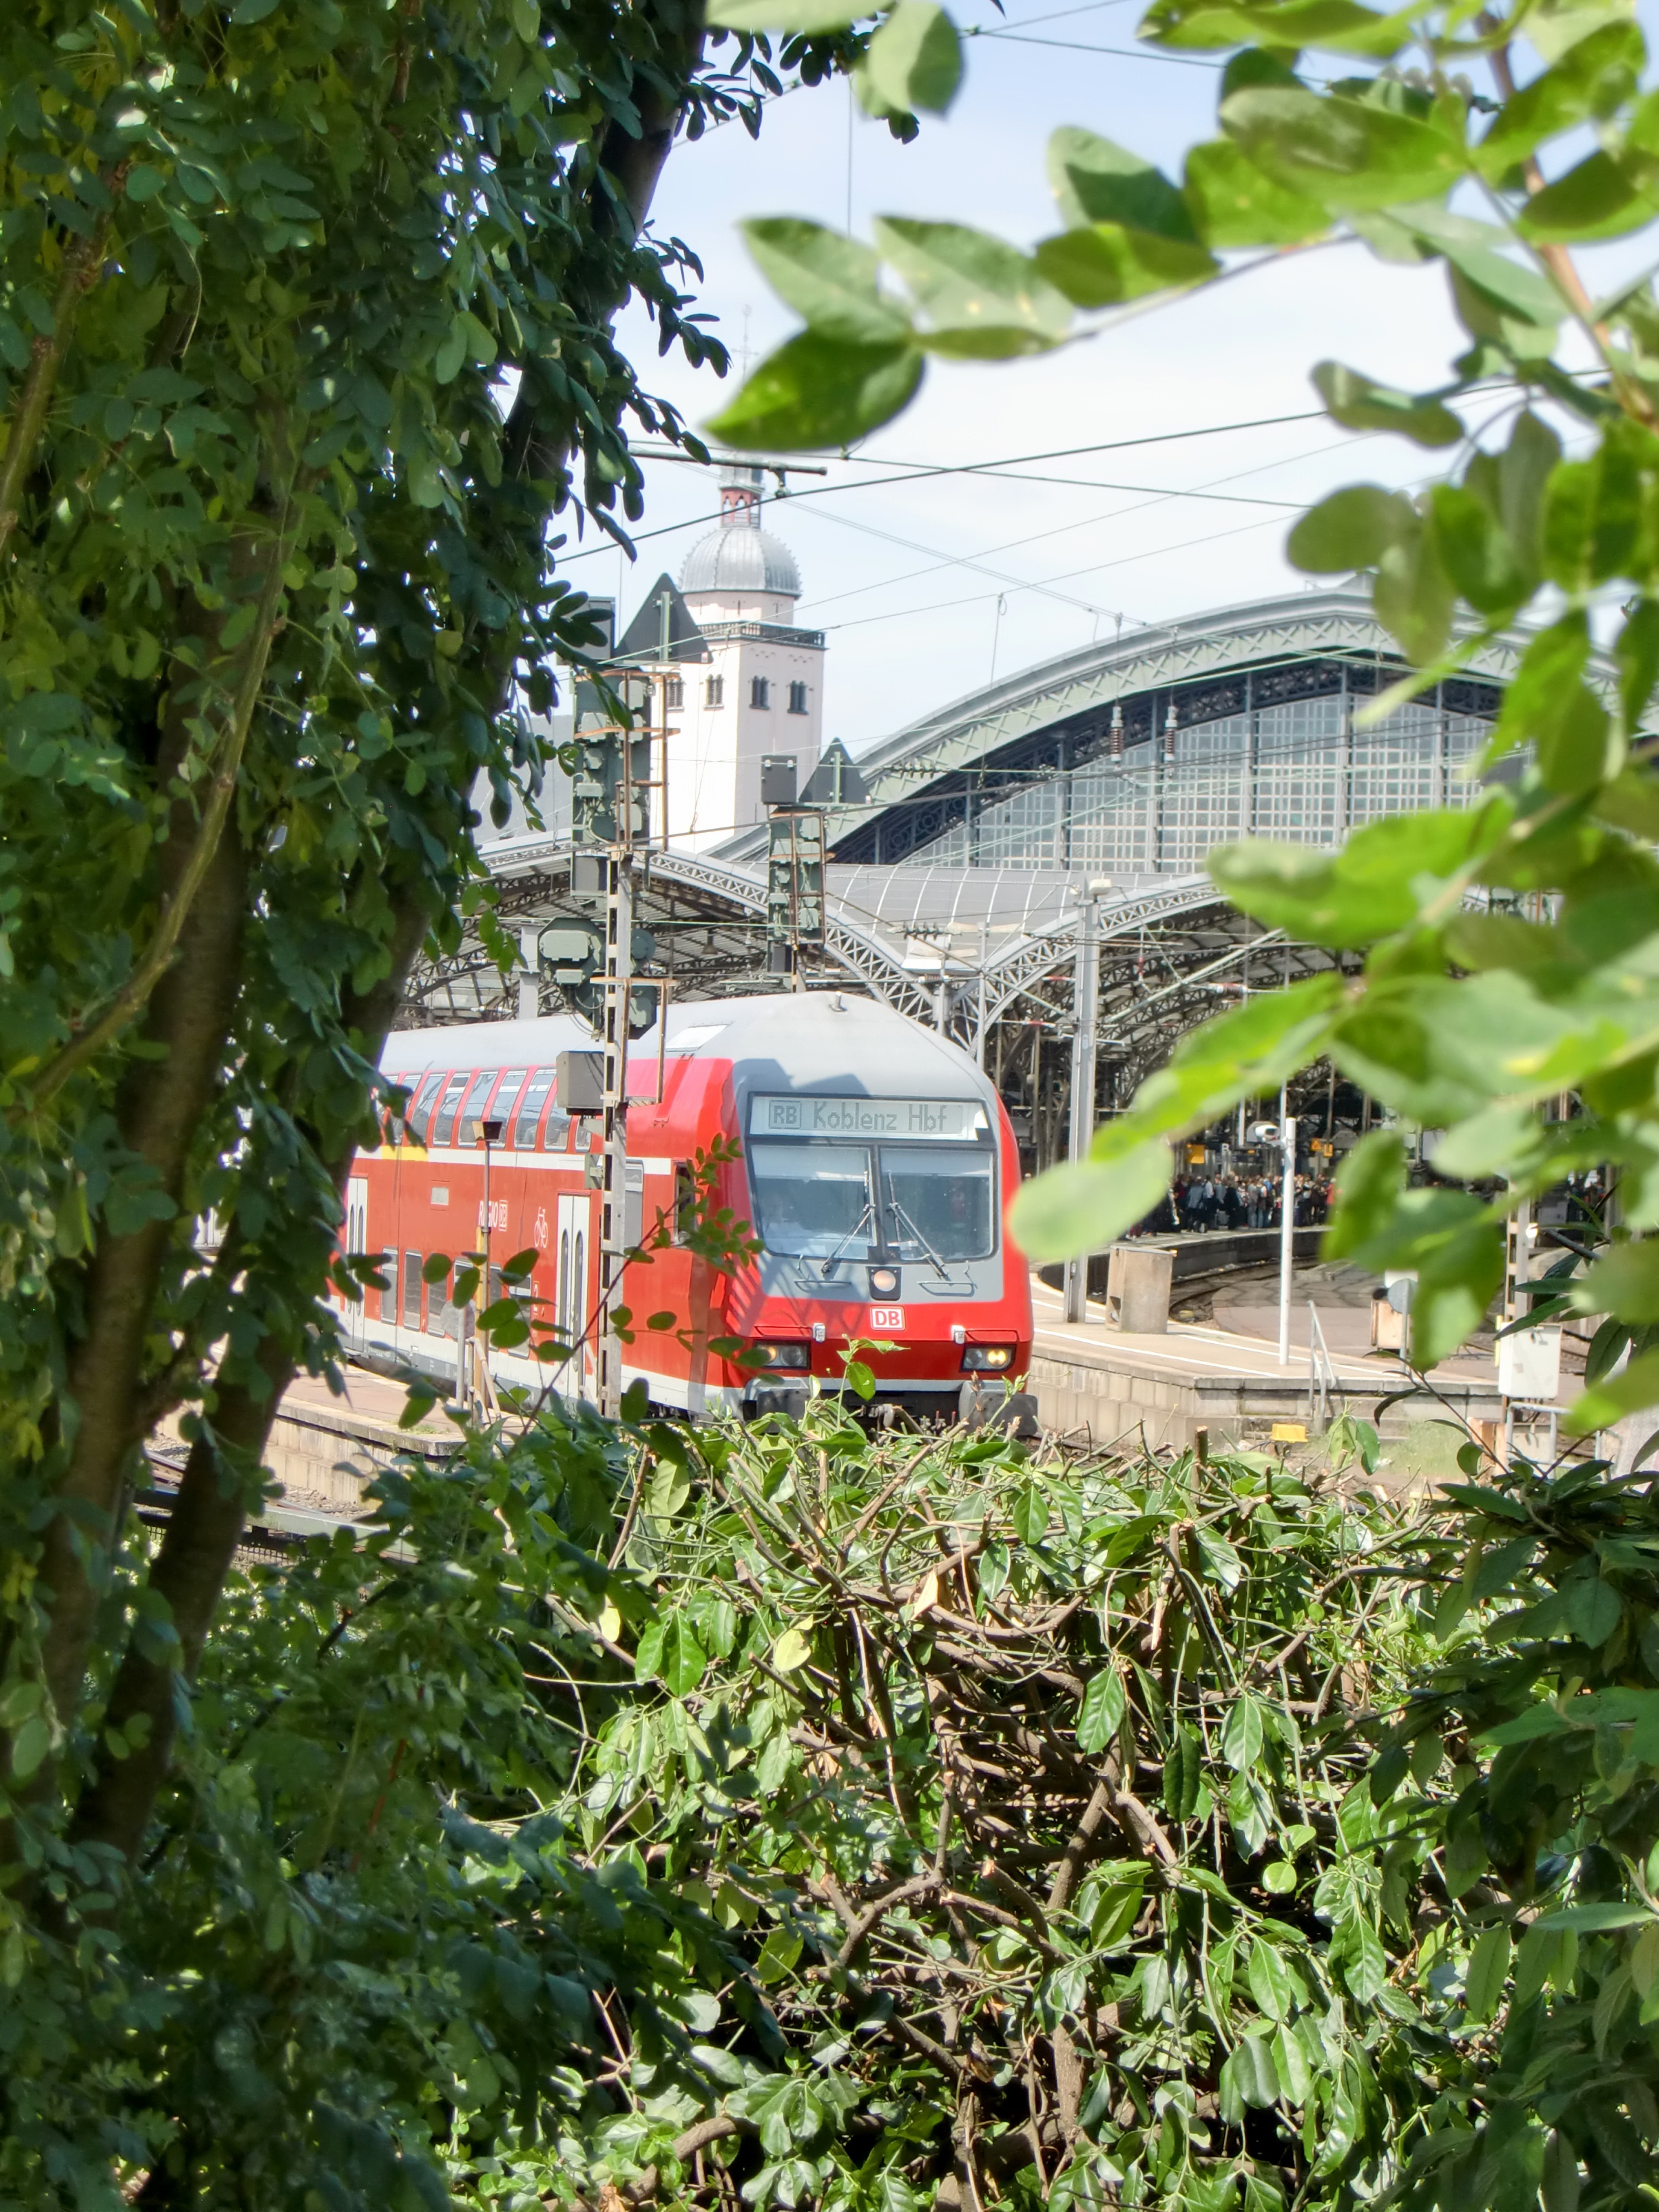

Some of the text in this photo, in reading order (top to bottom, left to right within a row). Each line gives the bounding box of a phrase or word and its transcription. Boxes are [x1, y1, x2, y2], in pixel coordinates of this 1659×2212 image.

[773, 1101, 947, 1132] RB Koblenz Hbf
[874, 1310, 901, 1326] DB
